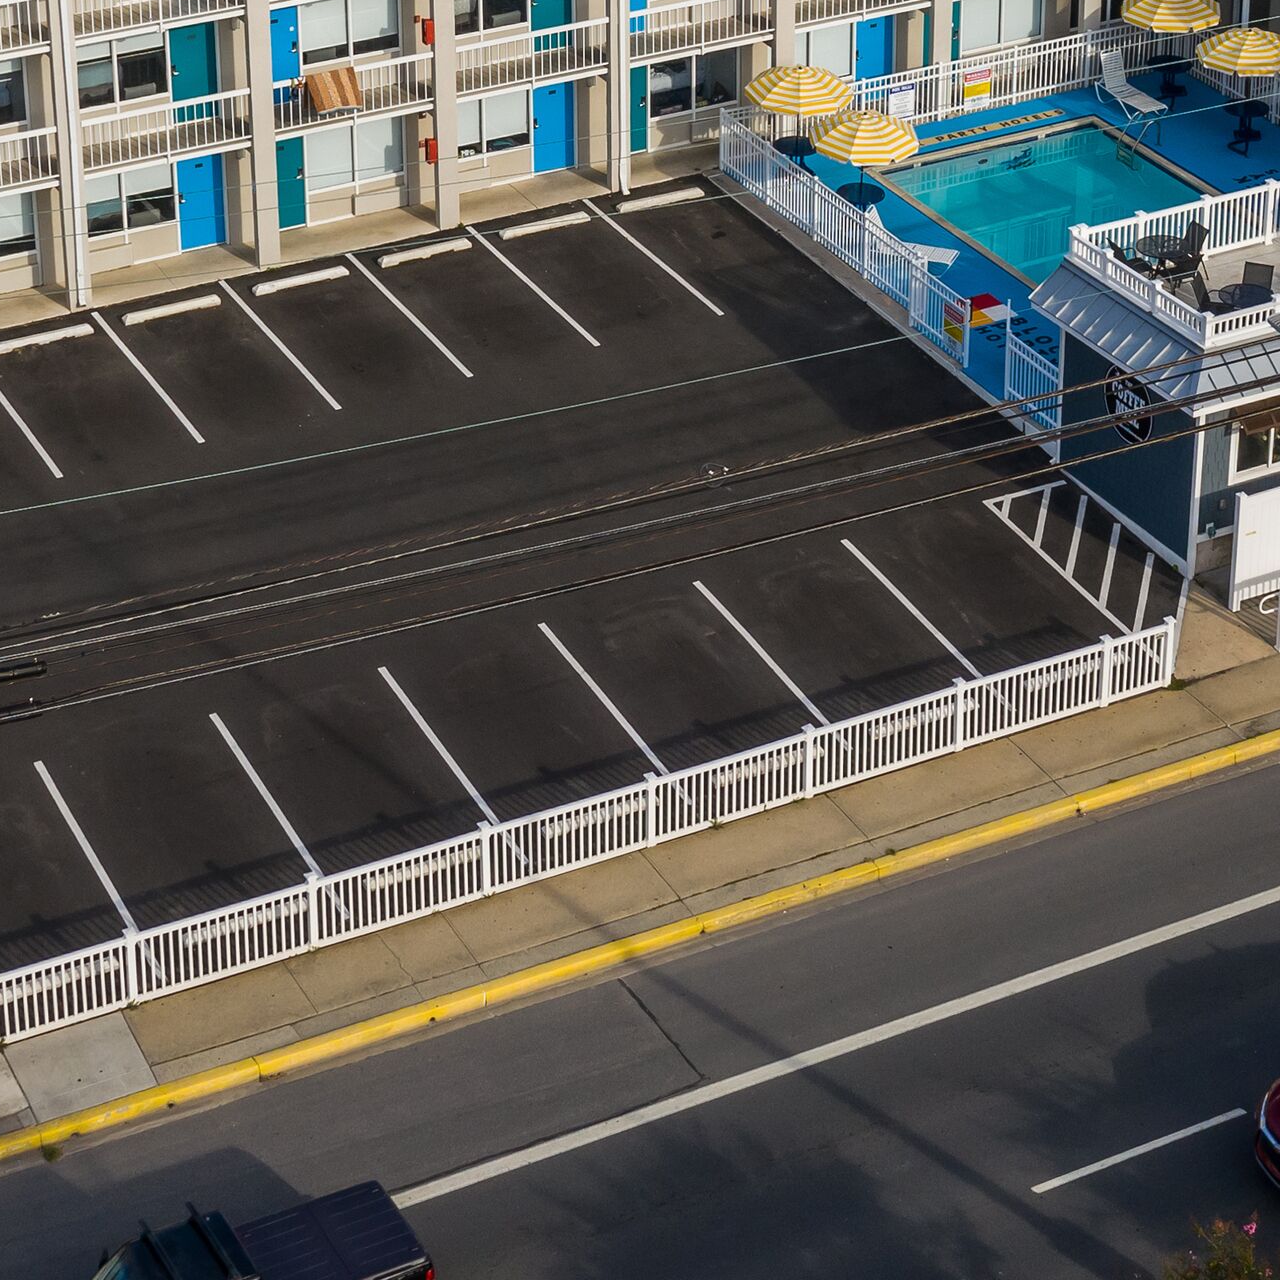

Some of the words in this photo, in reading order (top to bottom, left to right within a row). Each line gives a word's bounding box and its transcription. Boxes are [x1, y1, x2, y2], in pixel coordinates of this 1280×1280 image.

[935, 126, 988, 143] PARTY
[999, 109, 1064, 128] HOTELS
[1010, 317, 1059, 354] BLOC
